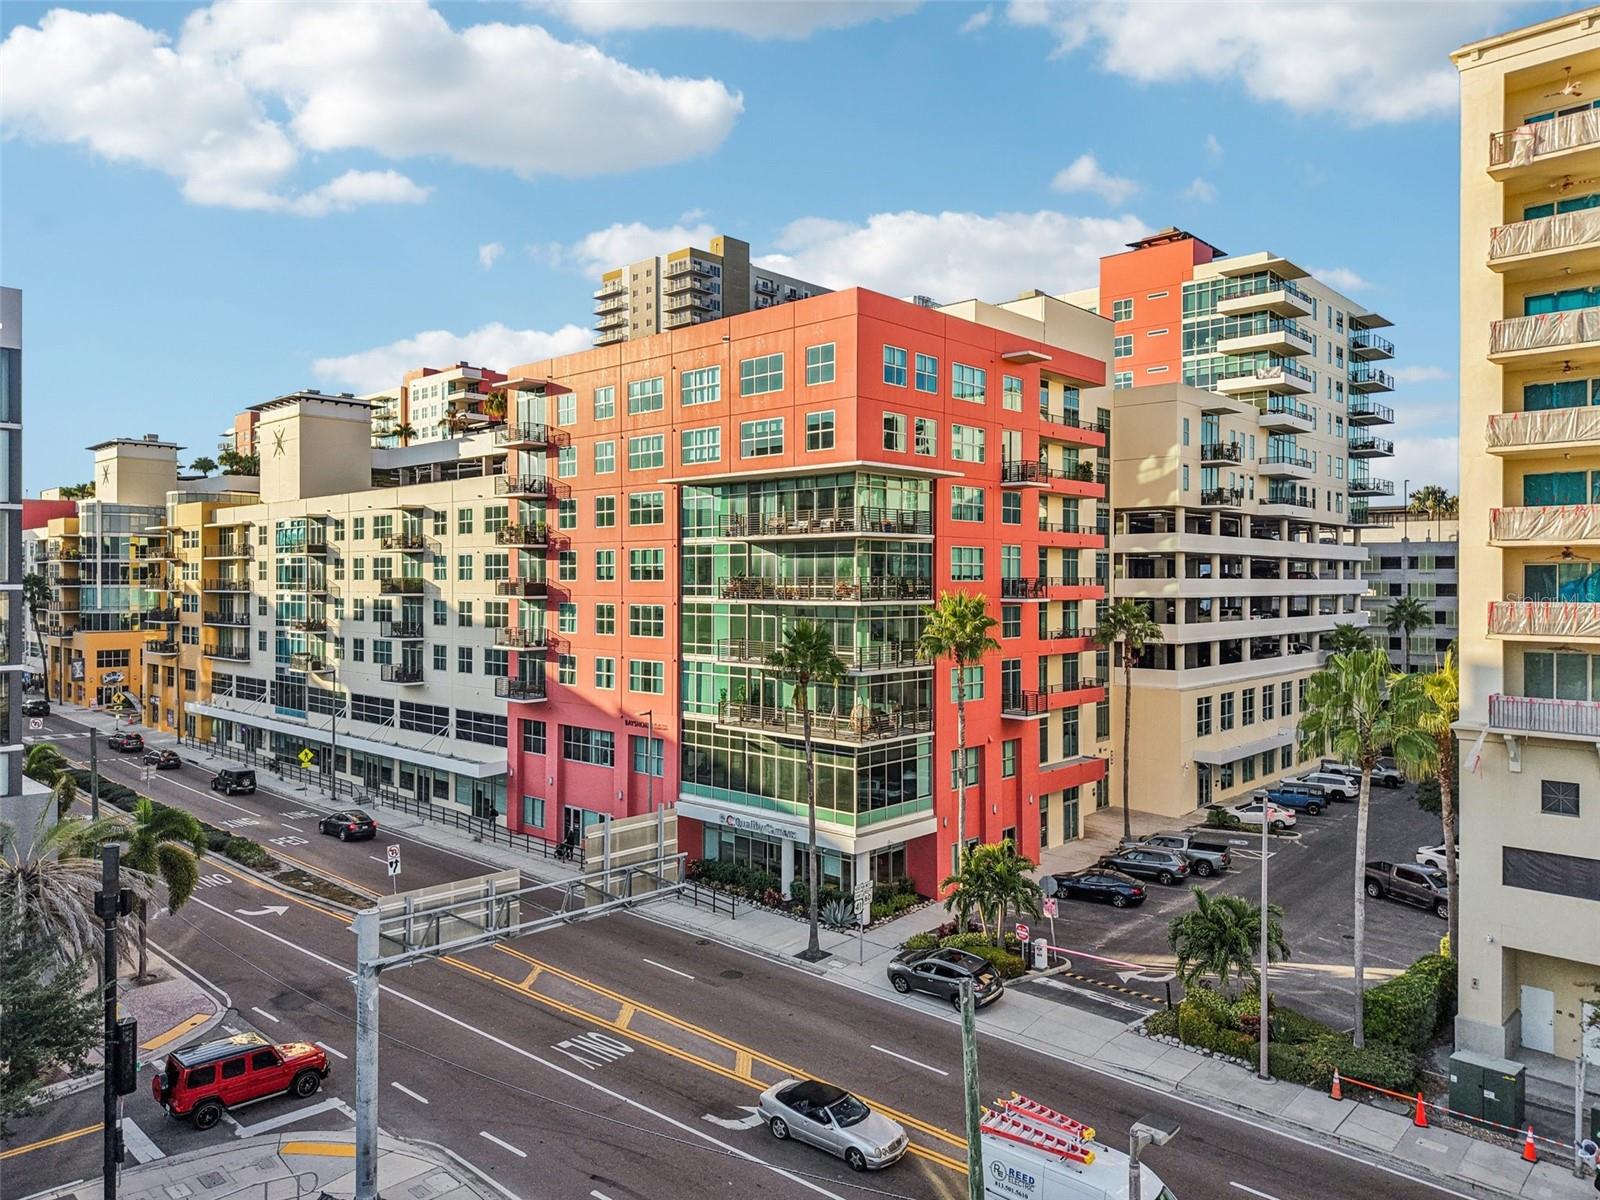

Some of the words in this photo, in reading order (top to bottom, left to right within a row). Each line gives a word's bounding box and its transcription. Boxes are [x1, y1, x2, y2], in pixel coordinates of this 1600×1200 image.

[218, 817, 260, 829] XING
[269, 835, 309, 848] PED
[550, 1031, 634, 1070] ONLY
[1008, 1168, 1035, 1185] REED
[1008, 1176, 1036, 1193] ELECTRIC
